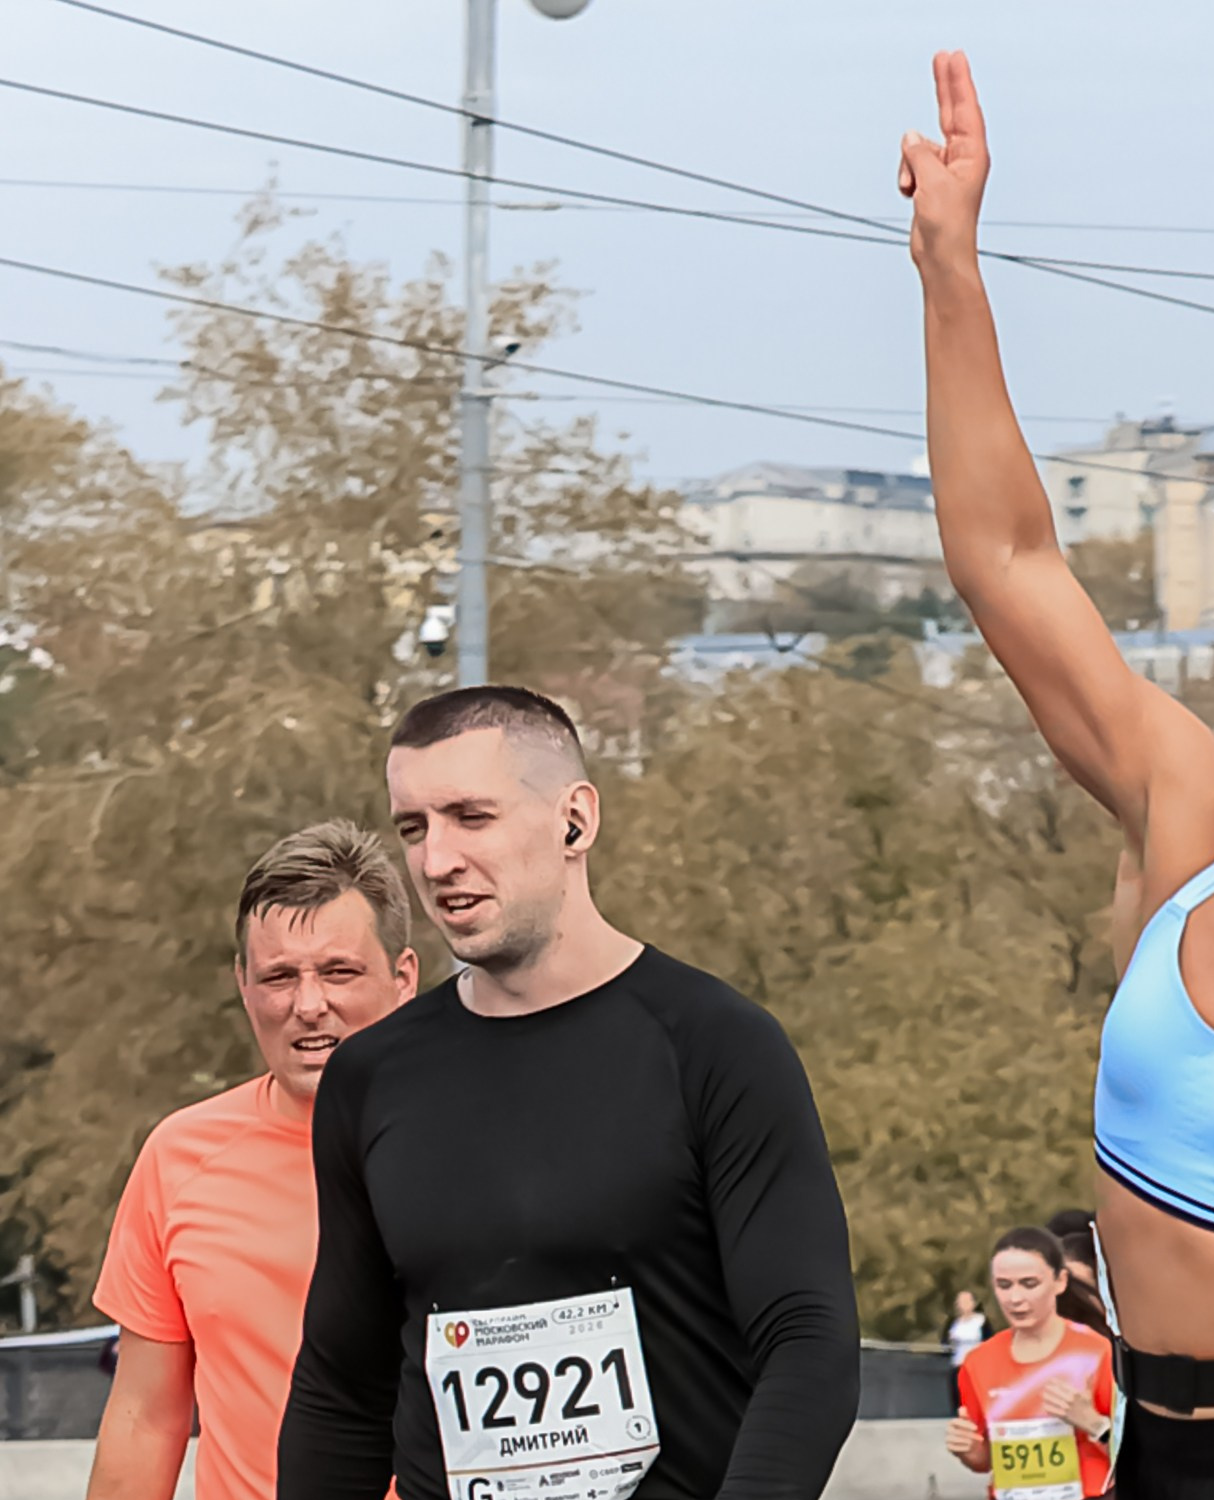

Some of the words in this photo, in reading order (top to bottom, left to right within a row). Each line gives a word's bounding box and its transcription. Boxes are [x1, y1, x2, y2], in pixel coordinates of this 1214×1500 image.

[558, 1307, 585, 1321] 42,2
[588, 1304, 608, 1316] КМ
[474, 1318, 549, 1336] МОСКОВСКИЙ
[475, 1333, 531, 1347] МАРАФОН
[442, 1347, 635, 1432] 12921
[499, 1425, 590, 1458] ДМИТРИЙ
[1000, 1440, 1065, 1471] 5916
